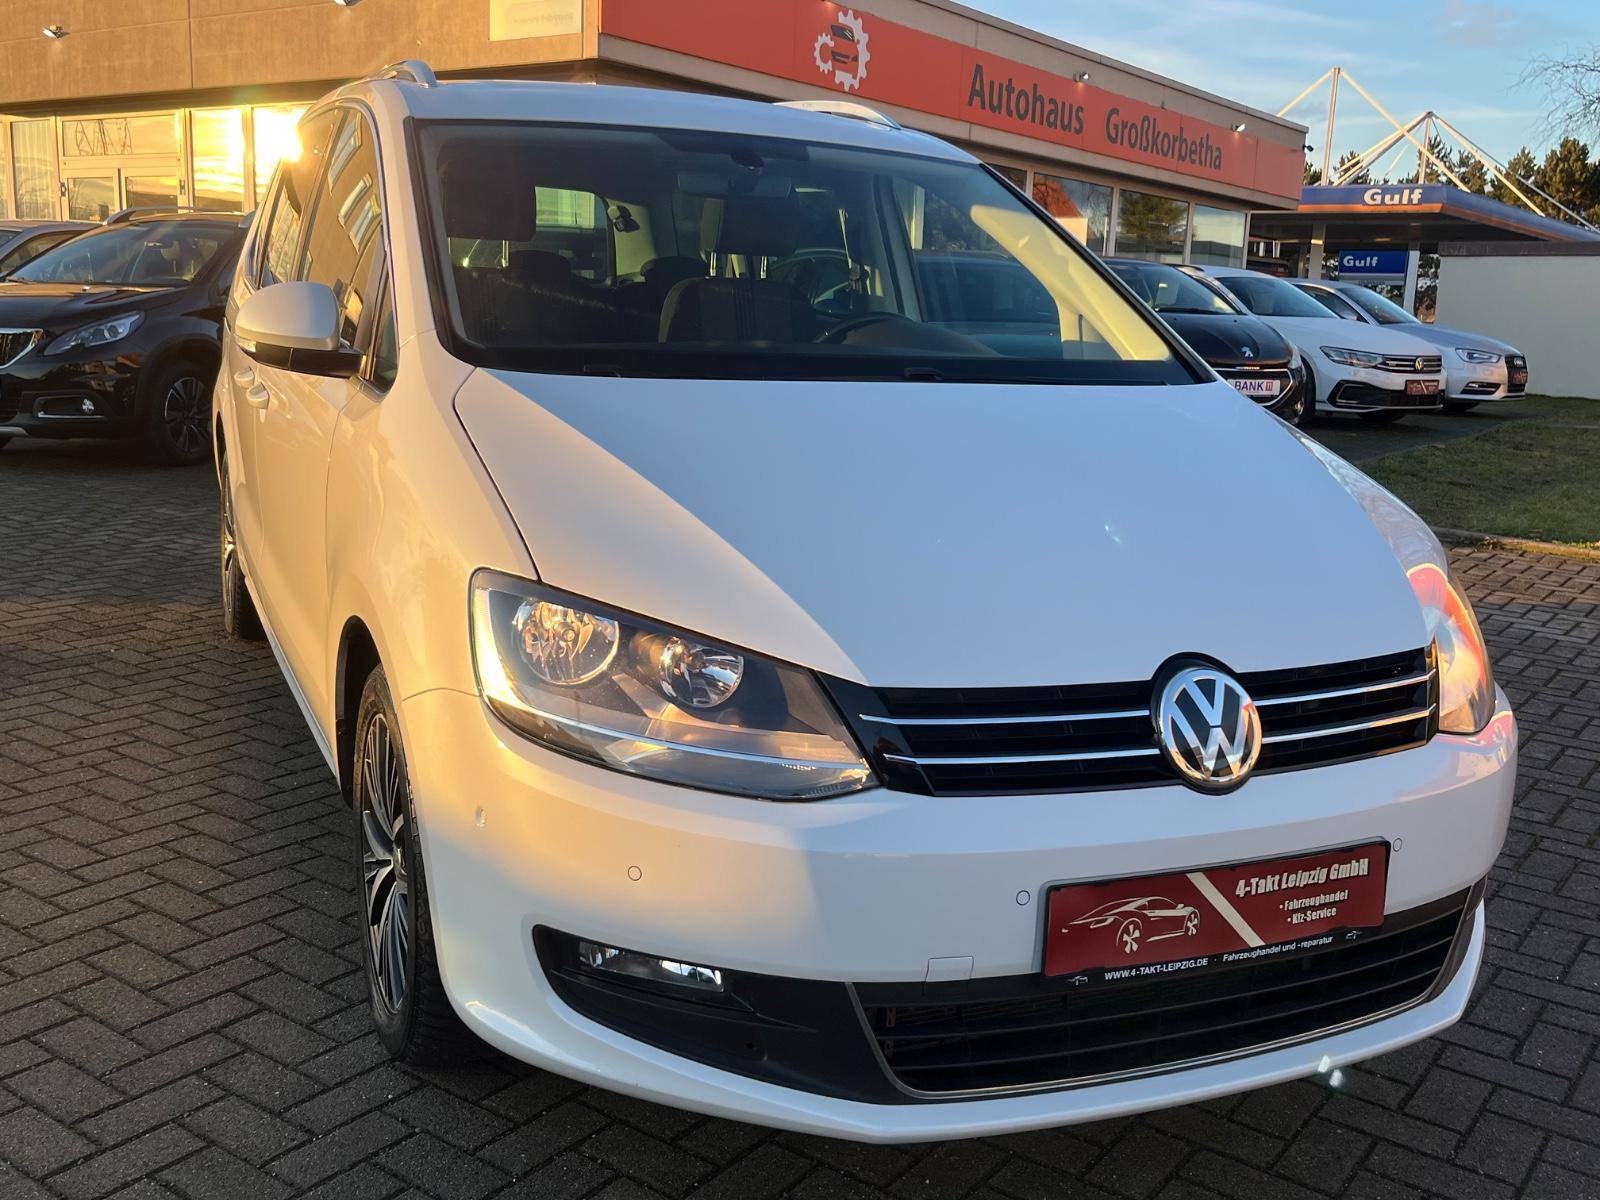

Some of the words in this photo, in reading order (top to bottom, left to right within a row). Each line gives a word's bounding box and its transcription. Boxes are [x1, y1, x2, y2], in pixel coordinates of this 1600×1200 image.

[967, 63, 1085, 135] Autohaus
[1105, 107, 1222, 171] Großkorbetha
[1363, 188, 1423, 205] Gulf
[1342, 255, 1379, 267] Gulf
[1234, 380, 1264, 392] BANK
[1235, 874, 1281, 898] 4-Takt
[1280, 867, 1329, 889] Leipzig
[1329, 858, 1369, 881] GmbH
[1284, 889, 1349, 911] Fahrzeughandel
[1292, 907, 1337, 924] Kfz-Service
[1104, 957, 1209, 981] WWW.4-TAKT-LEIPZIG.DE
[1222, 944, 1282, 963] Fahrzeughandel
[1281, 940, 1297, 952] und
[1296, 935, 1334, 950] -reparatur
